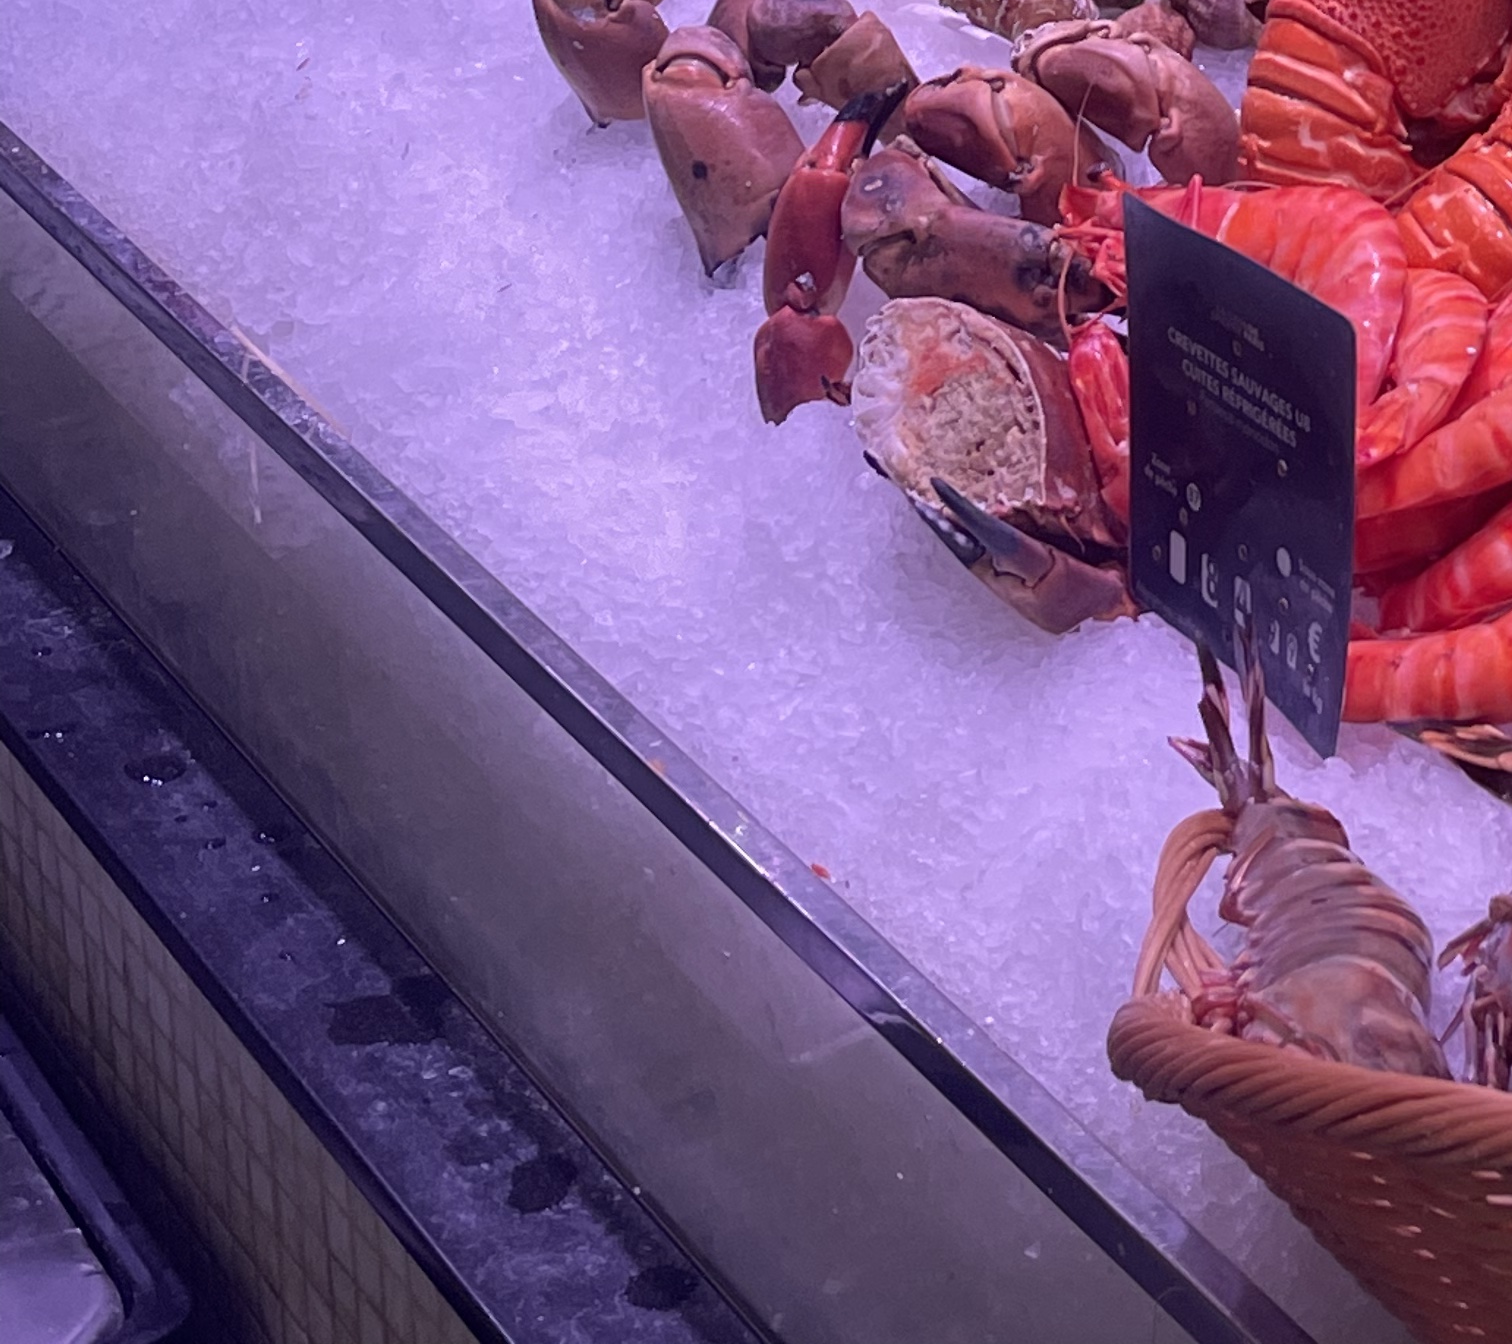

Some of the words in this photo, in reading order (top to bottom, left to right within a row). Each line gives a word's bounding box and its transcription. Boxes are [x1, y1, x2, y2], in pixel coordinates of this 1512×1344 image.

[1167, 326, 1230, 379] CREVETTES
[1230, 366, 1293, 420] SAUVAGES
[1181, 358, 1221, 396] CUITES
[1221, 384, 1297, 448] RÉFRIGÉRÉES
